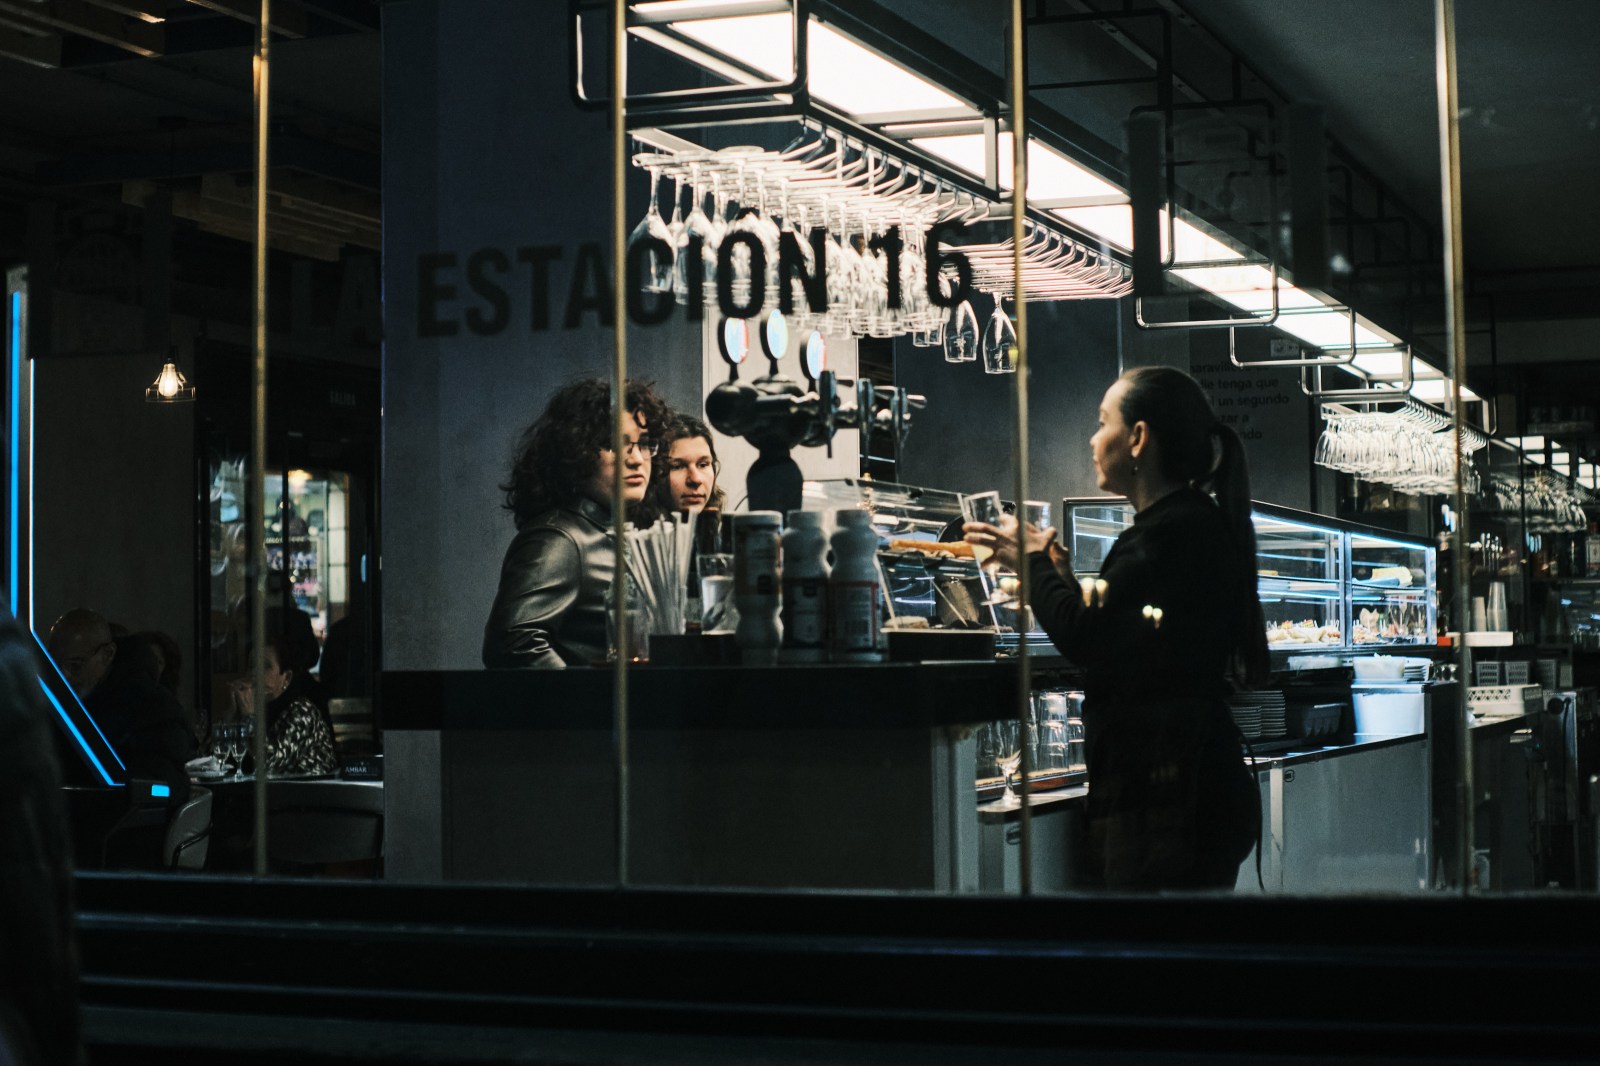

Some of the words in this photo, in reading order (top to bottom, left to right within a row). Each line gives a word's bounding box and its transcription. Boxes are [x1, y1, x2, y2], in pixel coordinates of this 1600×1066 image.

[290, 254, 385, 345] LA
[868, 222, 972, 309] 16
[1218, 379, 1252, 391] tenga
[1256, 377, 1279, 391] que
[1218, 398, 1233, 406] un
[1237, 393, 1290, 408] segundo
